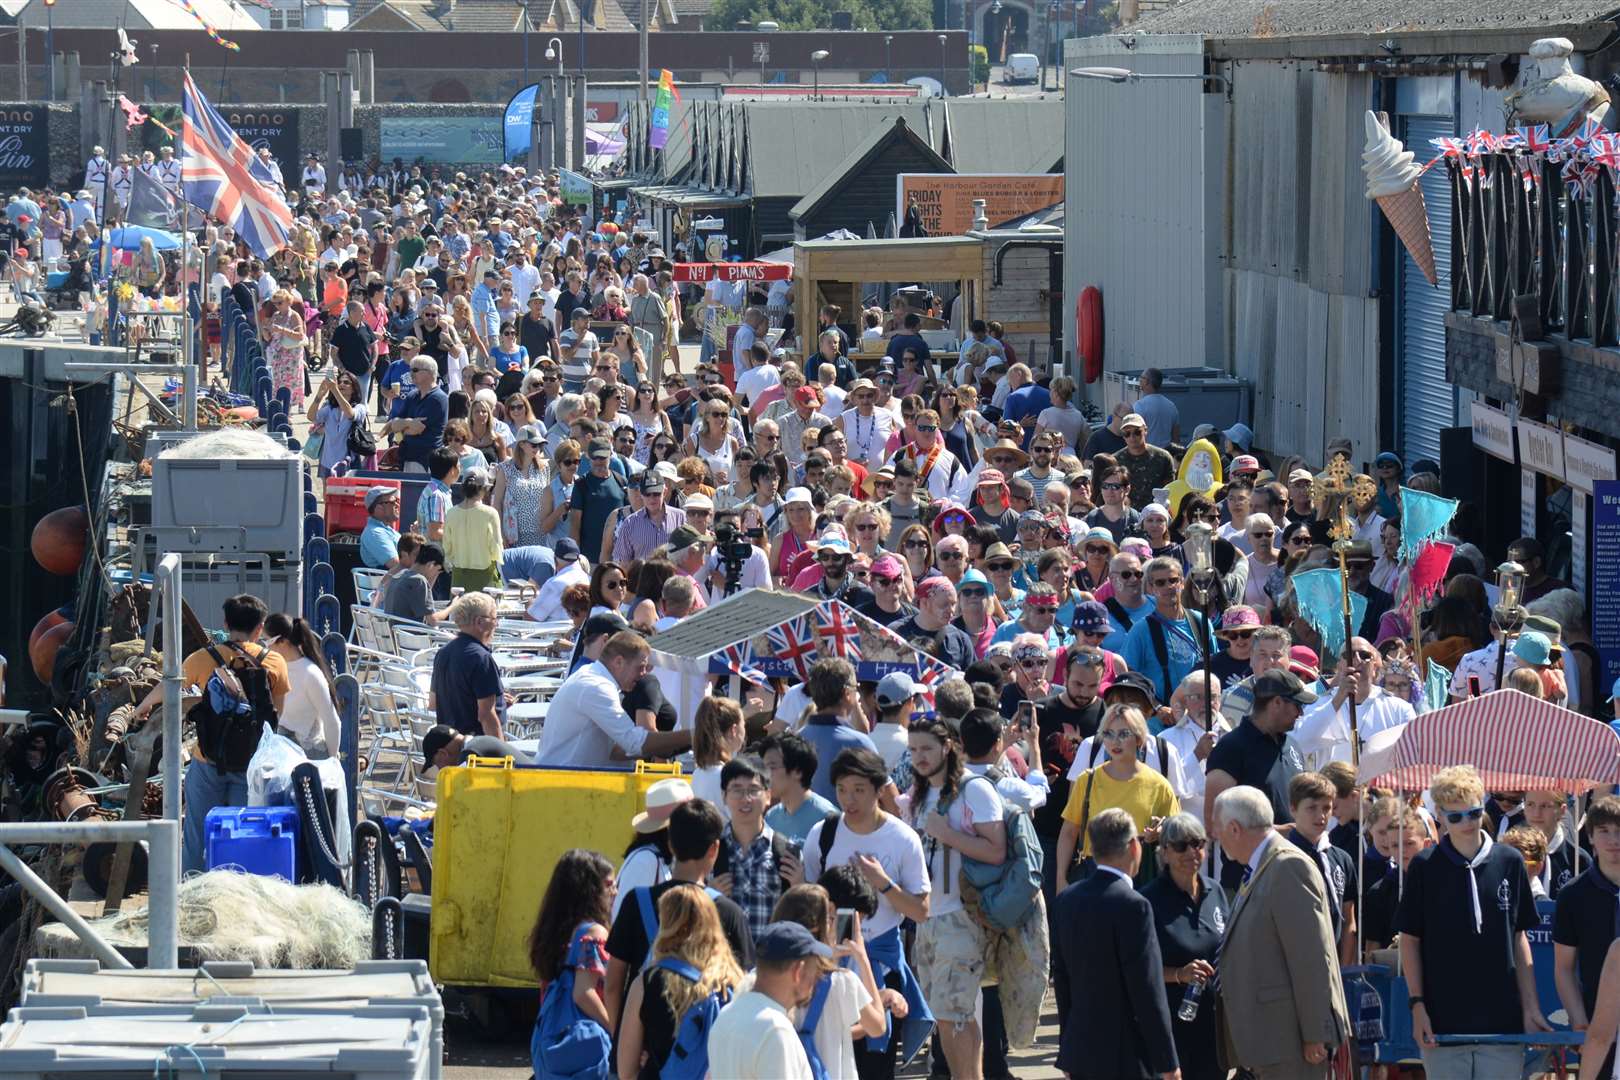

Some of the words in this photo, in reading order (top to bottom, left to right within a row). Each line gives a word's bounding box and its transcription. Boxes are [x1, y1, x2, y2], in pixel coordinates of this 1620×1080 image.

[13, 125, 33, 133] DRY
[261, 128, 282, 136] DRY
[0, 135, 33, 169] Gin
[907, 189, 942, 202] FRIDAY
[924, 217, 941, 229] THE
[728, 266, 765, 280] PIMM'S
